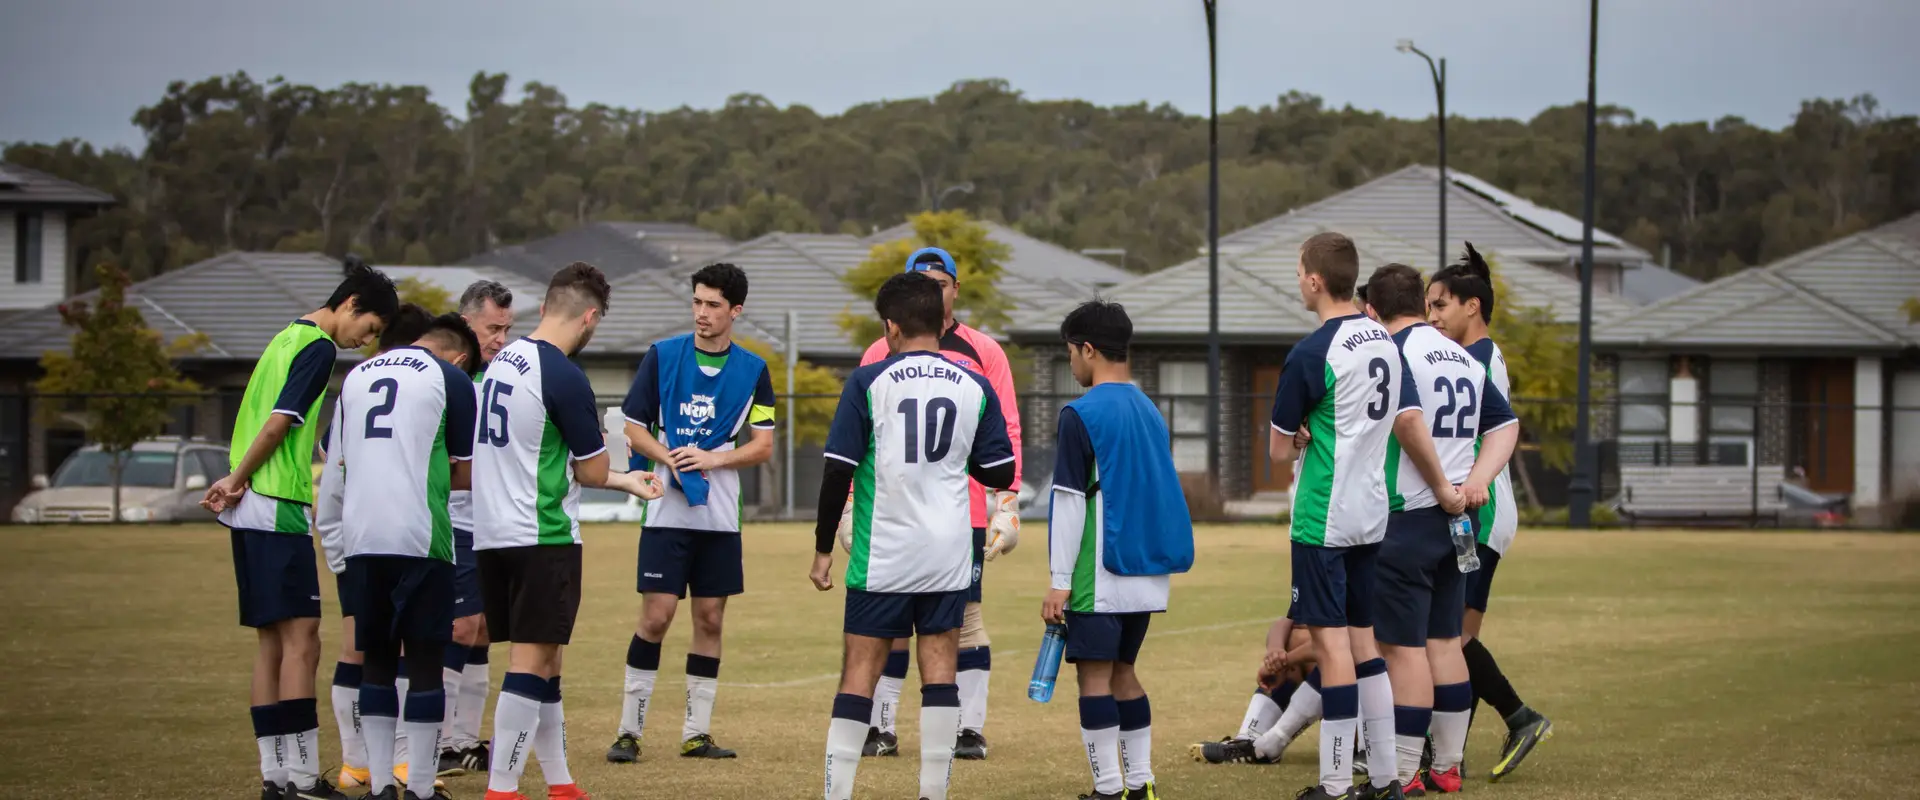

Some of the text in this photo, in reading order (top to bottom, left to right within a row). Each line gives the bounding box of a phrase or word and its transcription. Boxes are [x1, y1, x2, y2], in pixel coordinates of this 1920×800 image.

[360, 357, 429, 373] WOLLEMI
[889, 365, 963, 385] WOLLEMI
[1424, 350, 1471, 369] WOLLEMI
[364, 377, 399, 439] 2
[1367, 357, 1391, 421] 3
[1432, 376, 1477, 439] 22
[477, 378, 514, 448] 15
[897, 396, 957, 464] 10
[295, 732, 308, 765] OLLEMI
[508, 731, 528, 772] WOLLEMI
[1087, 742, 1100, 778] WOLLEMI
[1334, 736, 1343, 771] WOLLEMI
